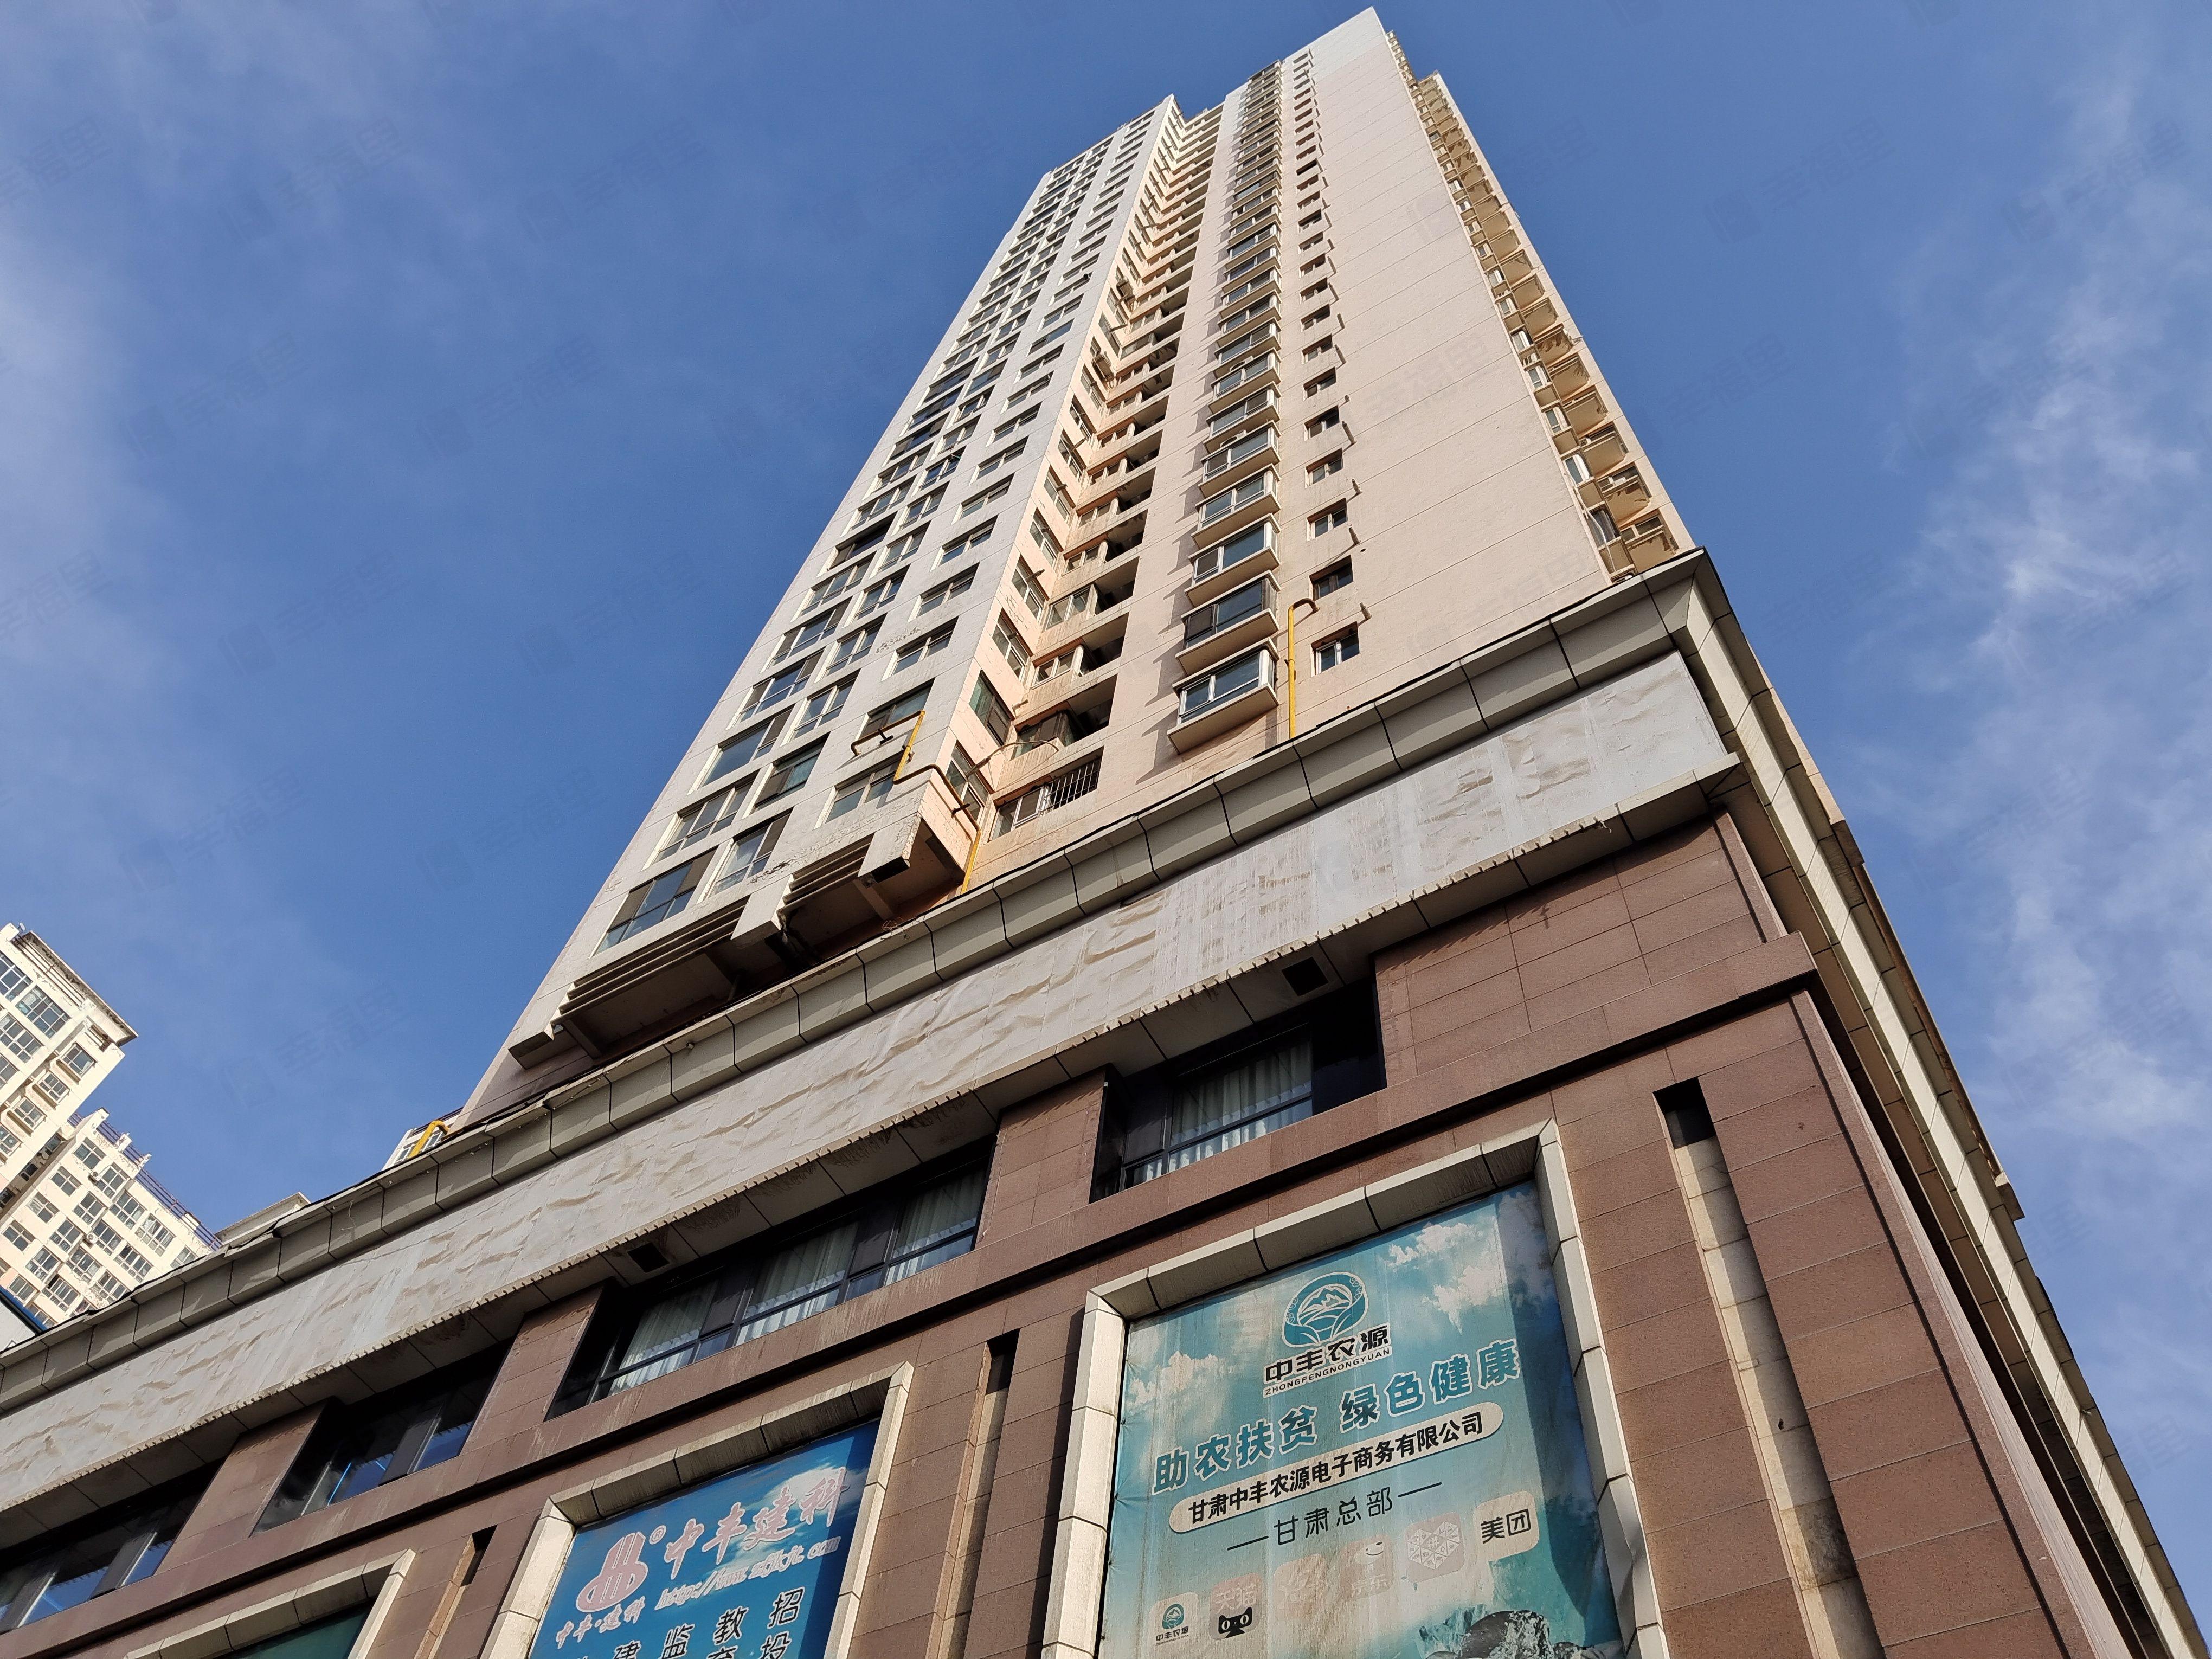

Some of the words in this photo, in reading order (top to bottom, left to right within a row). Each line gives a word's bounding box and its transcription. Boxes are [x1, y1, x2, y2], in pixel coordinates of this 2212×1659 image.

[1265, 1324, 1389, 1381] 中丰农源
[1265, 1348, 1390, 1396] ZHONGFENGNONGYUAN
[1152, 1405, 1317, 1495] 助农扶贫
[1339, 1338, 1520, 1433] 绿色健康
[1188, 1411, 1483, 1525] 甘肃中丰农源电子商务有限公司
[664, 1467, 850, 1579] 中丰建科
[1274, 1487, 1393, 1545] 甘肃总部
[1480, 1508, 1532, 1545] 美团
